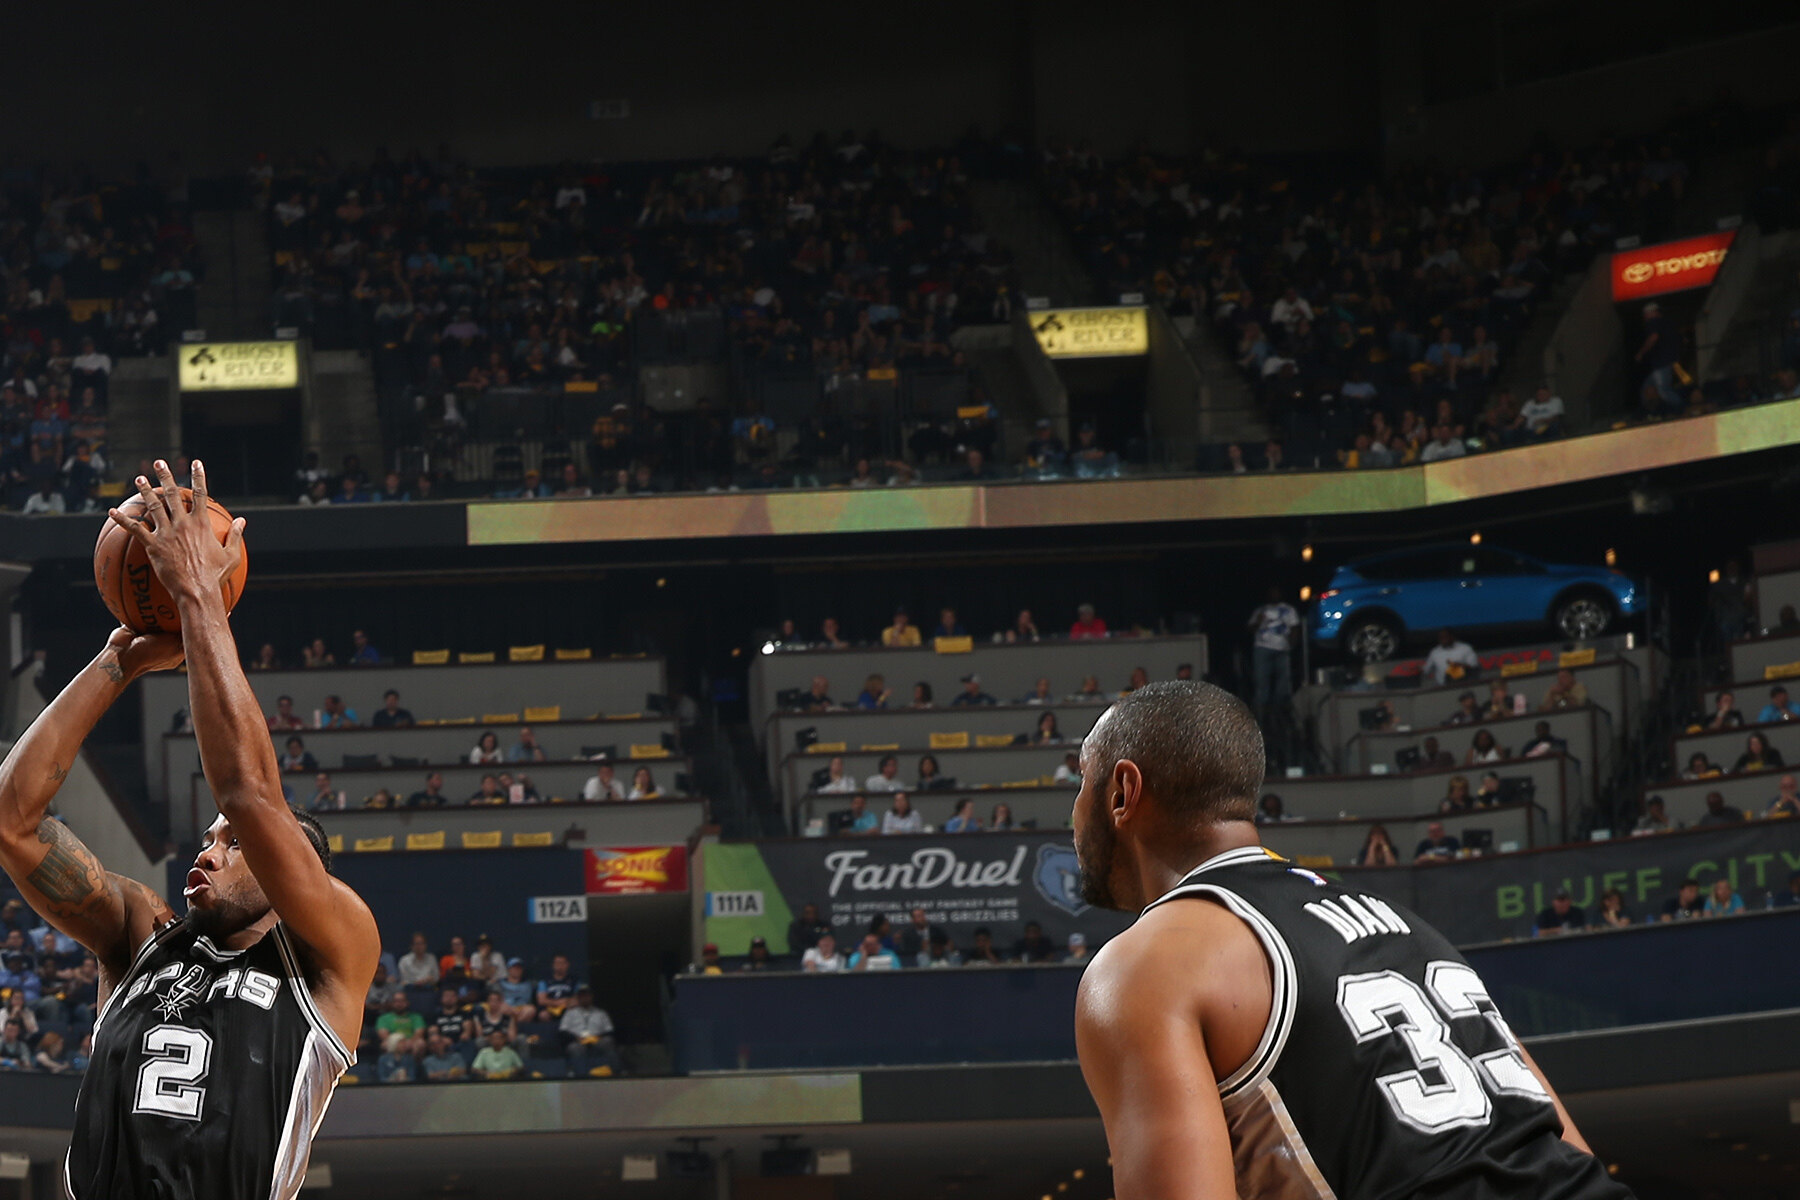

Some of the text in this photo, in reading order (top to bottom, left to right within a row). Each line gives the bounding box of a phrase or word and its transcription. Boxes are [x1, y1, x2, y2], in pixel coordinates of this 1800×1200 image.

[127, 563, 162, 633] SPALD
[602, 857, 665, 876] SONIC
[825, 846, 1028, 898] FanDuel
[538, 900, 583, 920] 112A
[716, 894, 759, 914] 111A
[950, 909, 1019, 922] GRIZZLIES
[1497, 867, 1662, 918] BLUFF
[131, 1023, 214, 1122] 2
[1336, 959, 1555, 1135] 33
